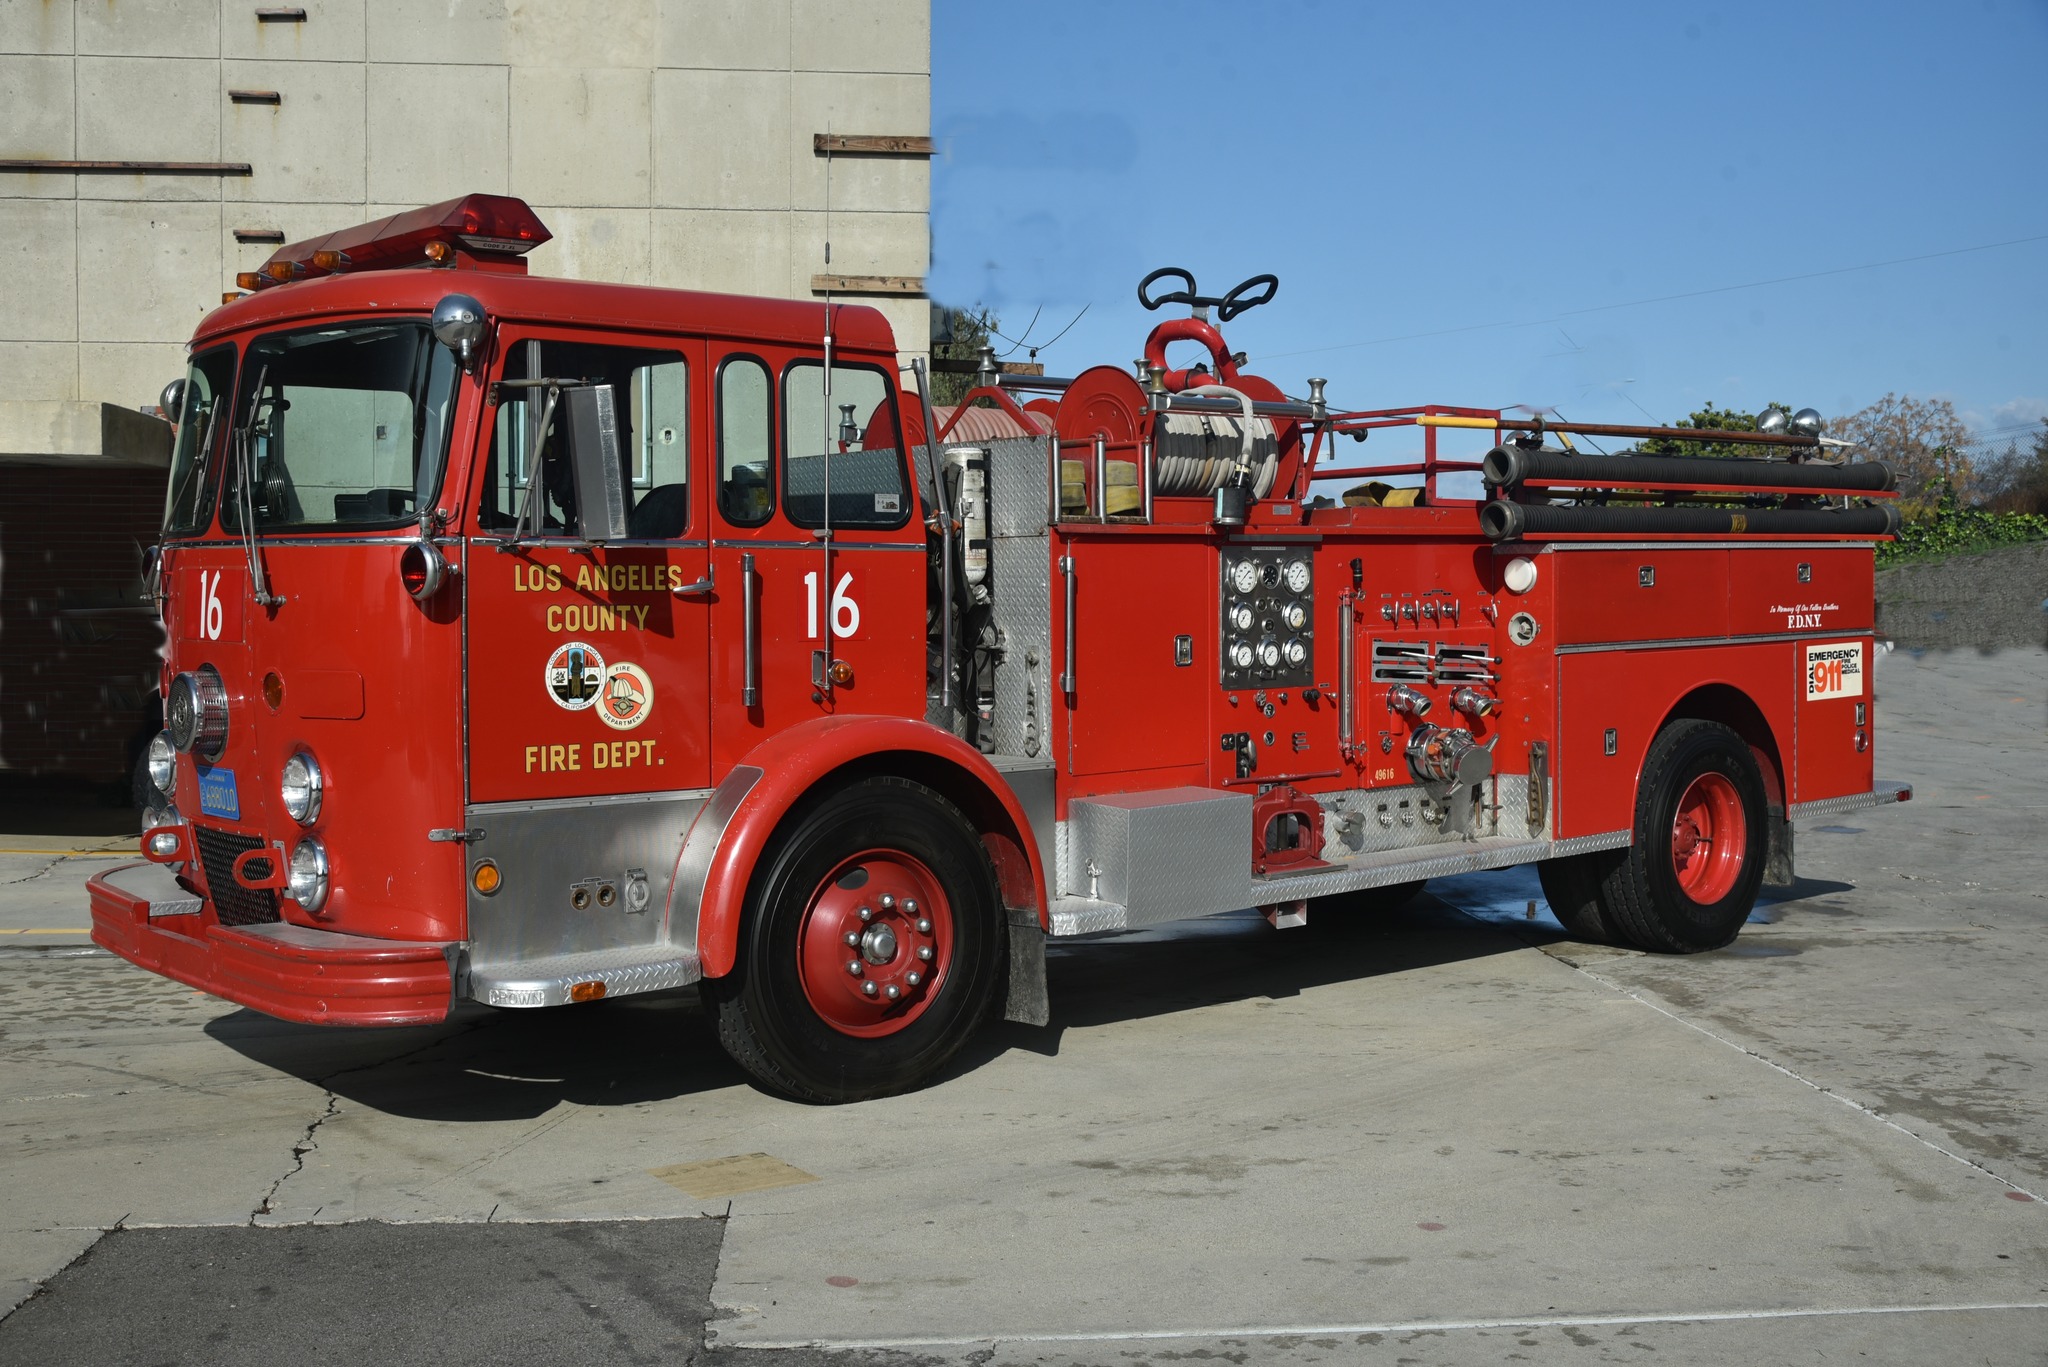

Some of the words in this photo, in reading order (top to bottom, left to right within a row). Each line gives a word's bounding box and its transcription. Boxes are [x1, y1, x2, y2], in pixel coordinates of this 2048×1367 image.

[514, 565, 562, 592] LOS
[575, 565, 682, 592] ANGELES
[200, 570, 223, 641] 16
[804, 571, 860, 639] 16
[546, 605, 650, 633] COUNTY
[1788, 614, 1822, 628] F.D.N.Y.
[548, 648, 564, 665] COUNTY
[585, 646, 603, 665] ANGELES
[1809, 649, 1860, 661] EMERGENCY
[1814, 660, 1842, 693] 911
[560, 701, 592, 710] CALIFORNIA
[603, 711, 644, 726] DEPARTMENT
[525, 743, 581, 773] FIRE
[593, 739, 665, 769] DEPT.
[1375, 768, 1394, 780] 49616
